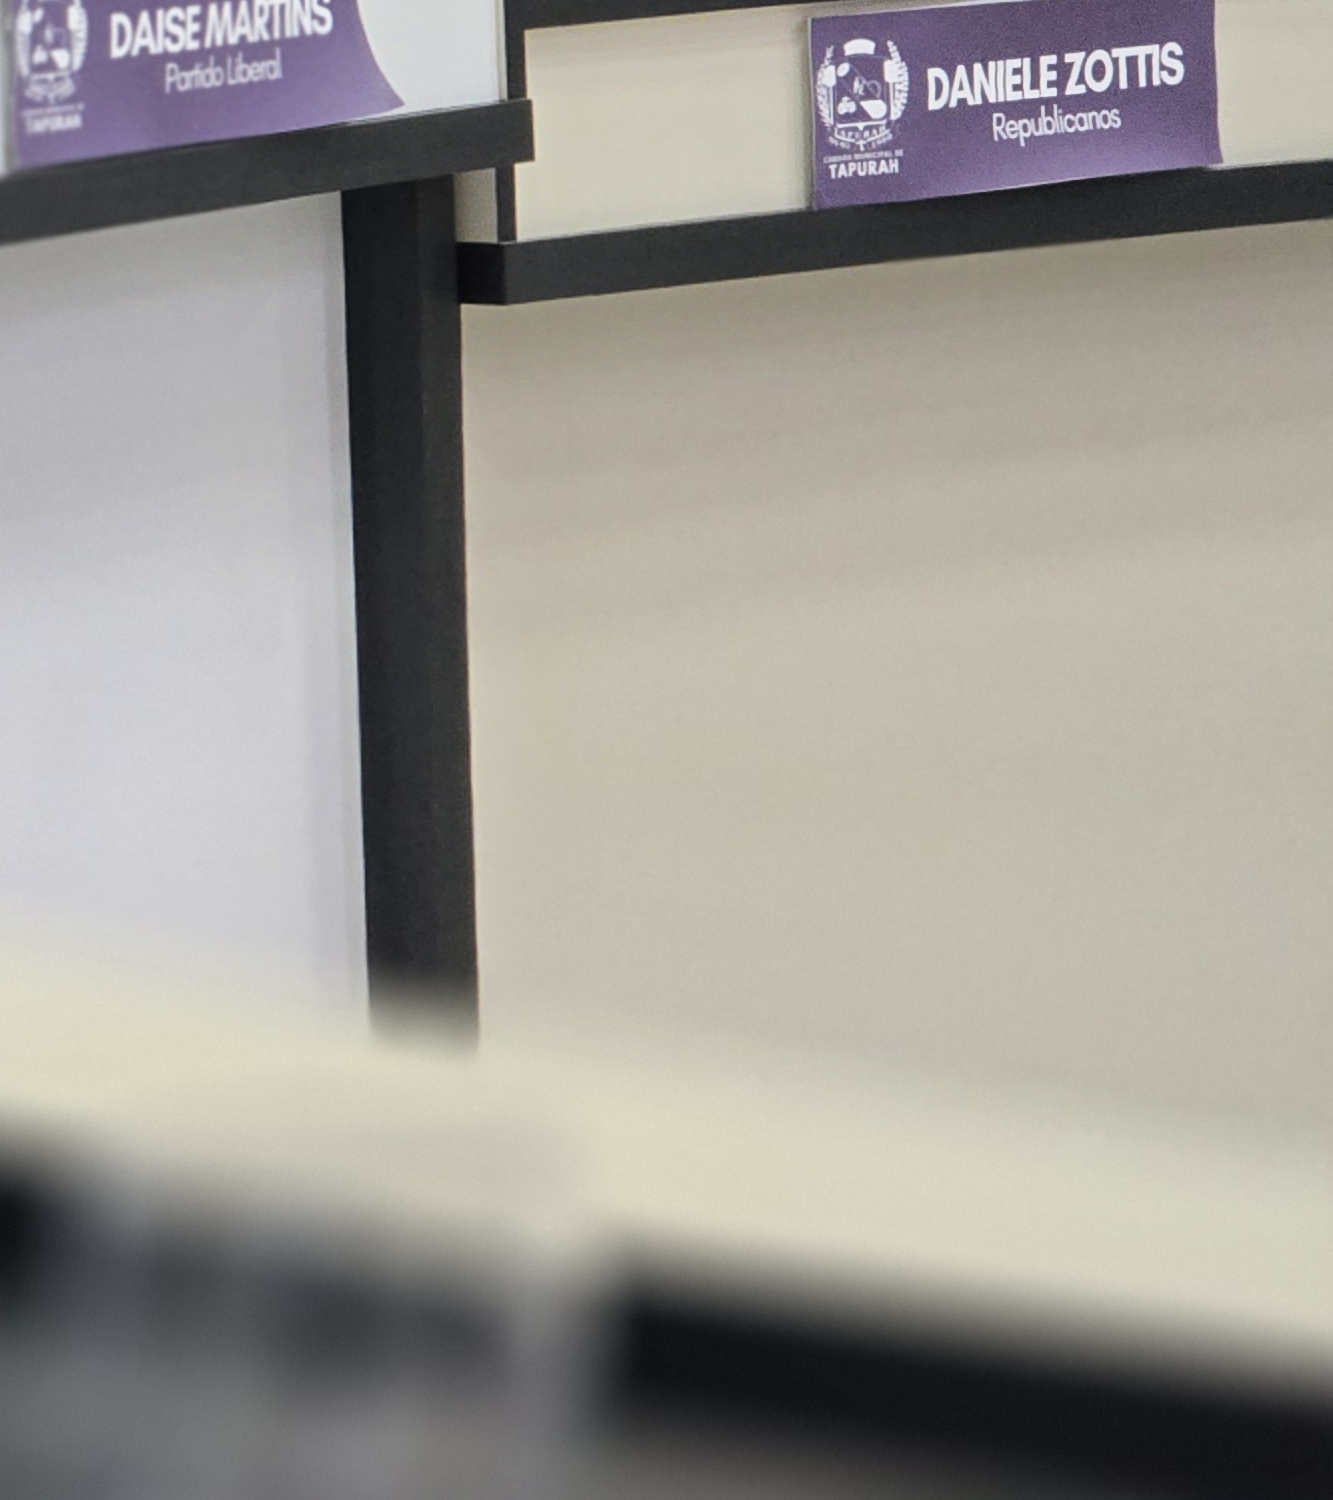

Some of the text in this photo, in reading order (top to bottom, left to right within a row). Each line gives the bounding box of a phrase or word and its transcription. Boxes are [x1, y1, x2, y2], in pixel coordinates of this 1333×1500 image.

[110, 1, 202, 59] DAISE
[164, 48, 282, 94] Partido Liberal
[926, 41, 1185, 112] DANIELE ZOTTIS
[992, 104, 1122, 148] Republicanos
[828, 158, 900, 179] TAPURAH
